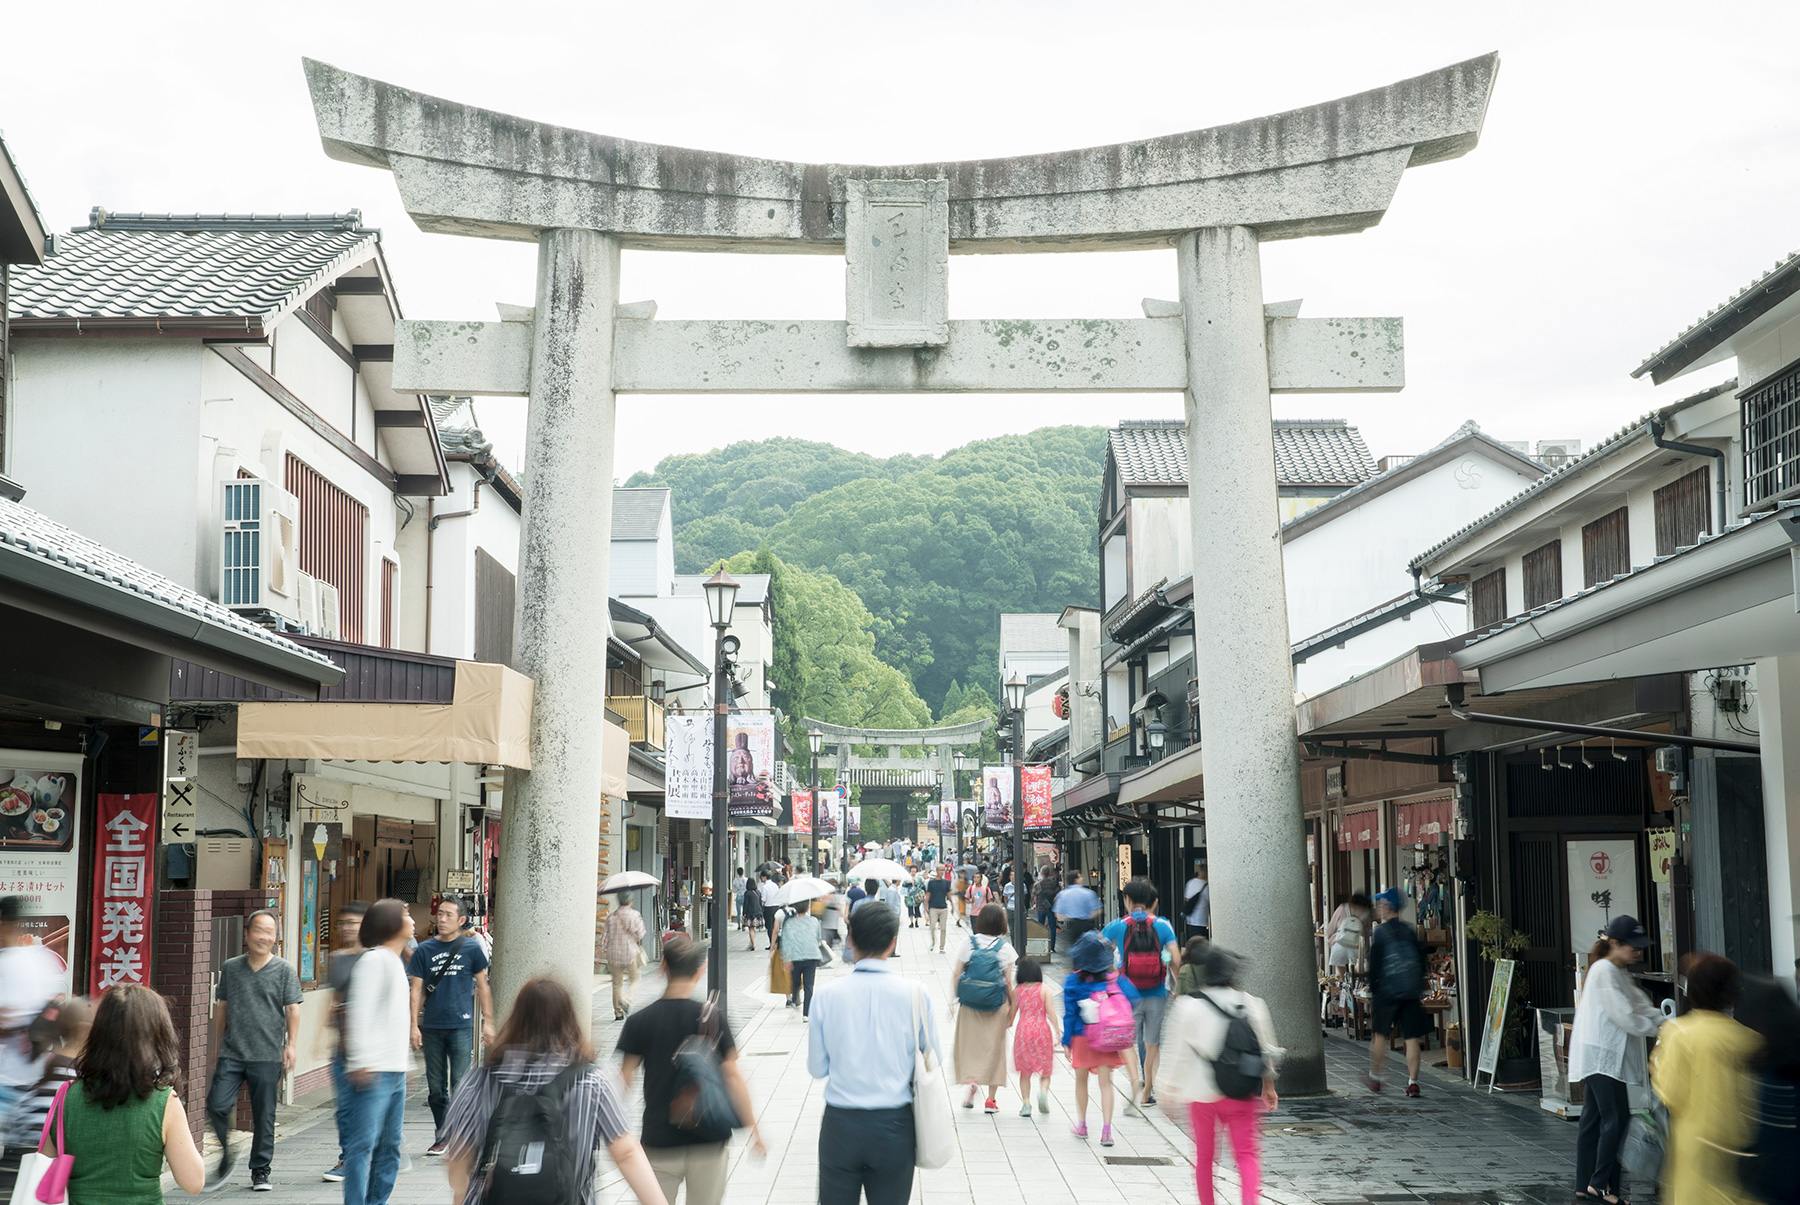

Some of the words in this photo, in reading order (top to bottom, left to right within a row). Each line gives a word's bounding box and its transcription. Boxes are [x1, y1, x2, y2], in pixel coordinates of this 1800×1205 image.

[177, 747, 187, 775] ふくや
[97, 810, 149, 989] 全国発送
